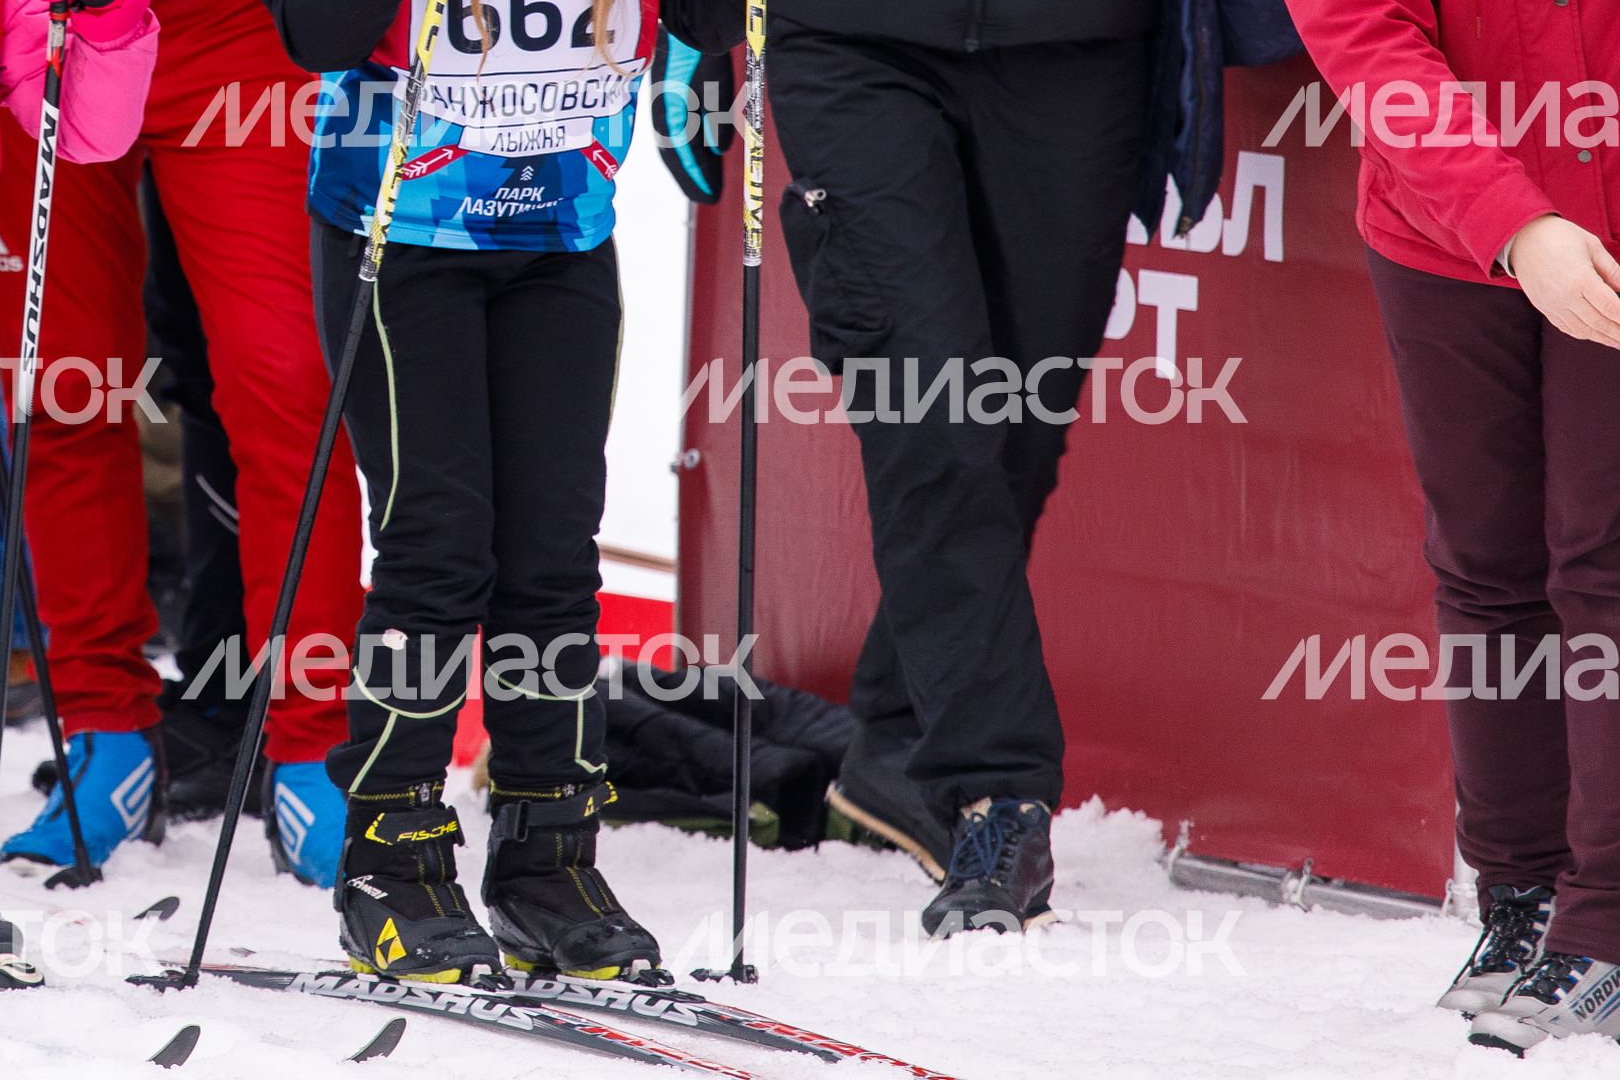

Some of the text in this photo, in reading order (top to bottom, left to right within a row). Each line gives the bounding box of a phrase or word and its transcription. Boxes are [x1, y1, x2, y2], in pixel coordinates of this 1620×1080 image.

[491, 125, 566, 151] ЛЫЖНЯ
[494, 187, 545, 202] ПАРК
[21, 110, 58, 373] MADSHUS
[289, 972, 534, 1031] MADSHUS
